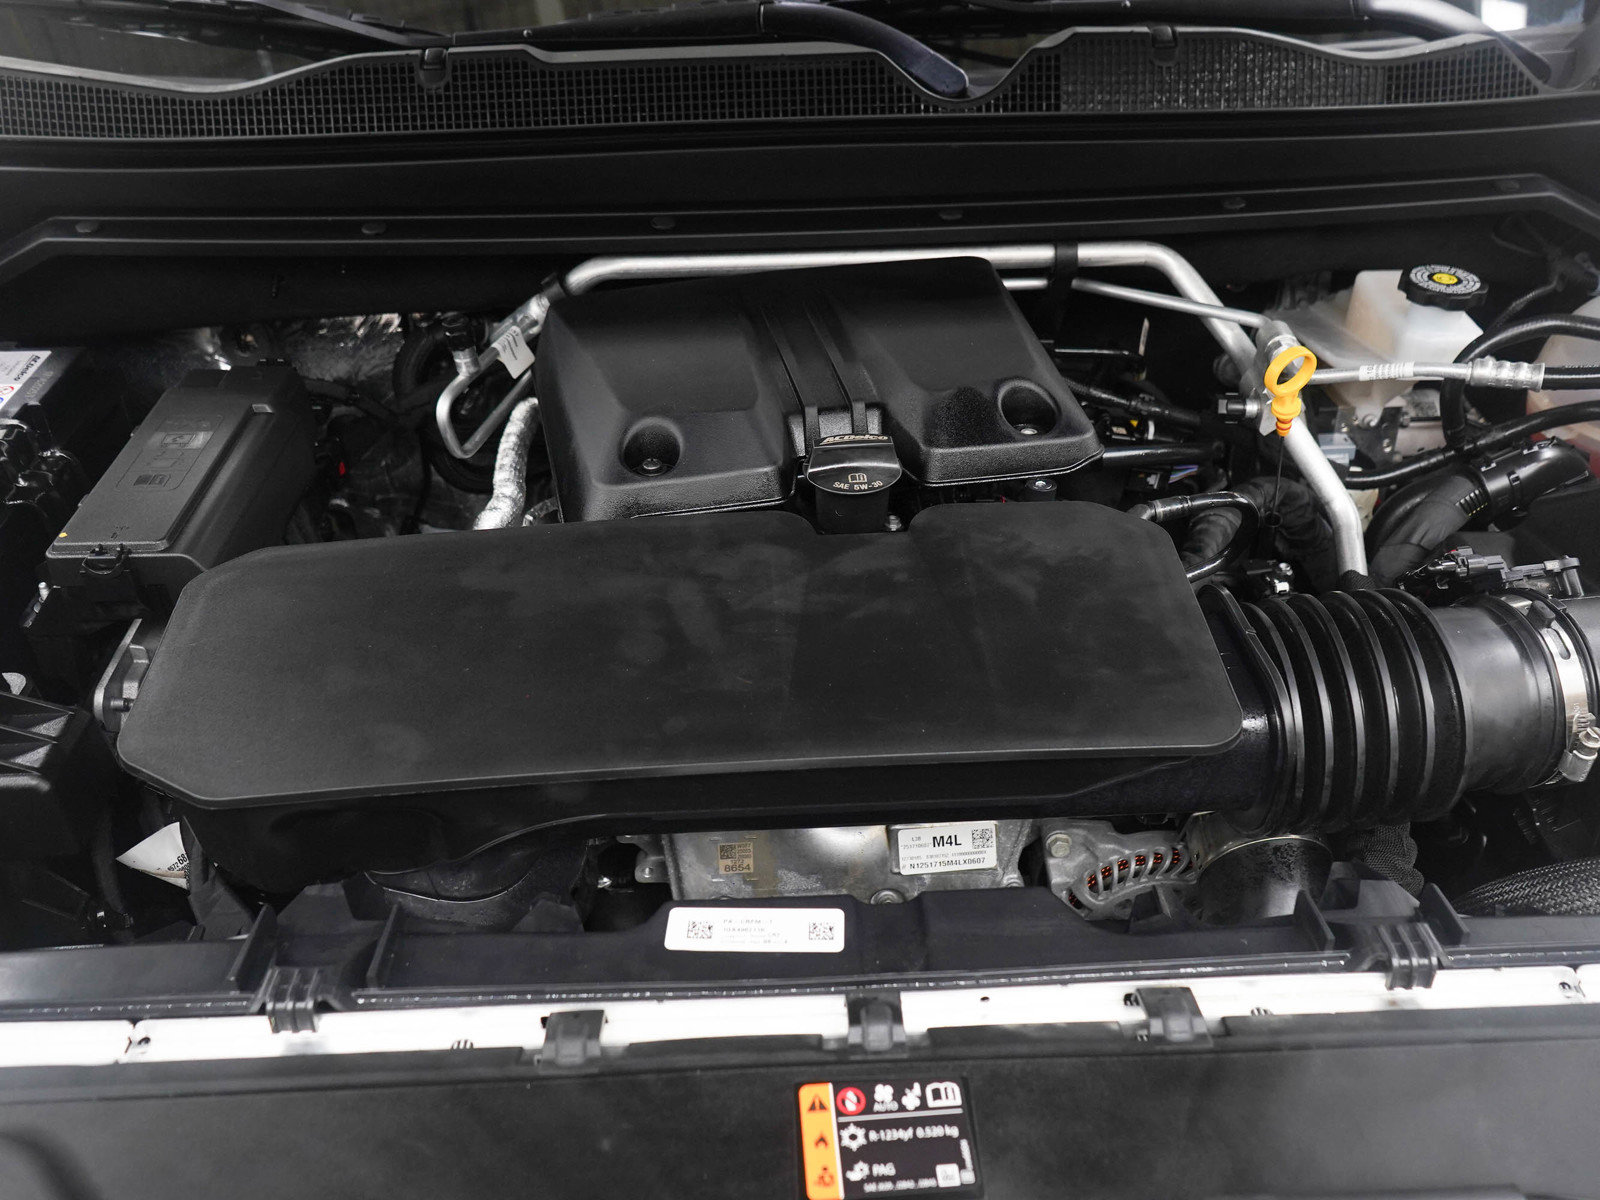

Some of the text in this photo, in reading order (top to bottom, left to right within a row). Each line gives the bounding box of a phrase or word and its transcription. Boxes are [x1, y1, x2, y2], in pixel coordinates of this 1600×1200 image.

[819, 434, 889, 446] ACDelco
[833, 480, 883, 490] SAE 5W-30
[932, 834, 962, 848] M4L
[724, 863, 751, 873] 8654
[874, 1101, 898, 1112] AUTO
[869, 1127, 913, 1141] R-1234yf
[945, 1124, 959, 1138] kg
[872, 1162, 896, 1176] PAG
